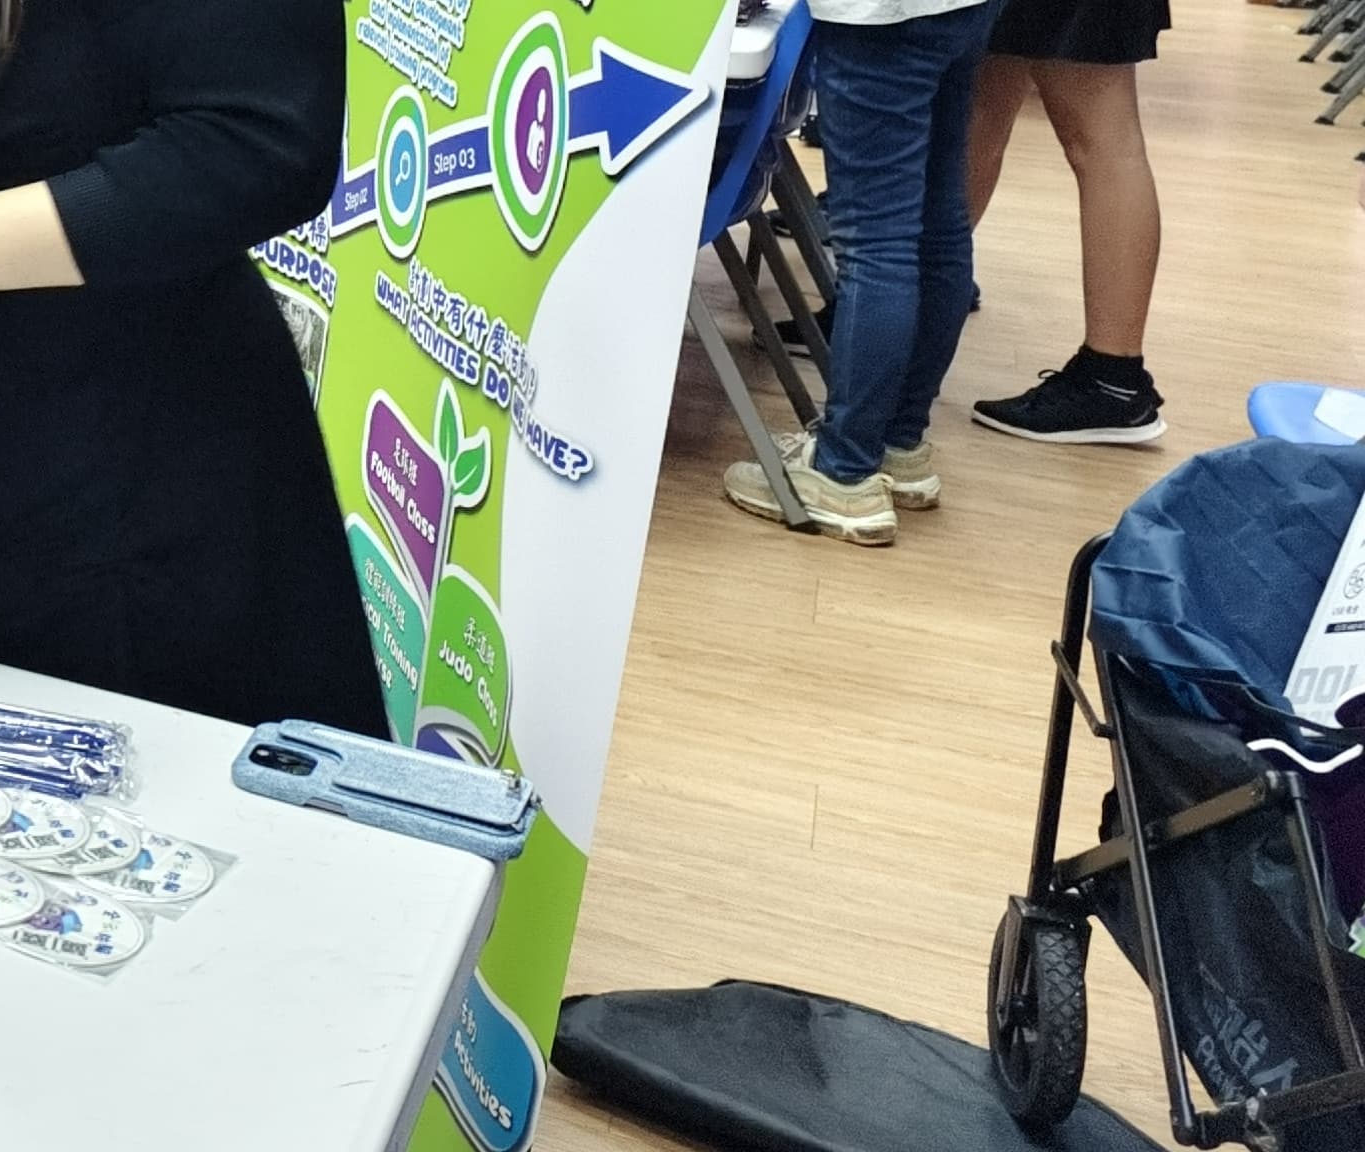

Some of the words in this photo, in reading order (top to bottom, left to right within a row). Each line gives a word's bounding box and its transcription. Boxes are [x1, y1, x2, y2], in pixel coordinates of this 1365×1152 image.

[457, 147, 476, 170] 03
[377, 274, 409, 319] WHAT
[410, 310, 479, 381] ACTIVITIES
[485, 367, 510, 403] DO
[370, 450, 405, 510] Football
[407, 501, 436, 545] Class
[383, 622, 418, 691] Training
[439, 640, 474, 684] Judo
[477, 676, 498, 728] Class
[454, 1029, 512, 1129] Activities
